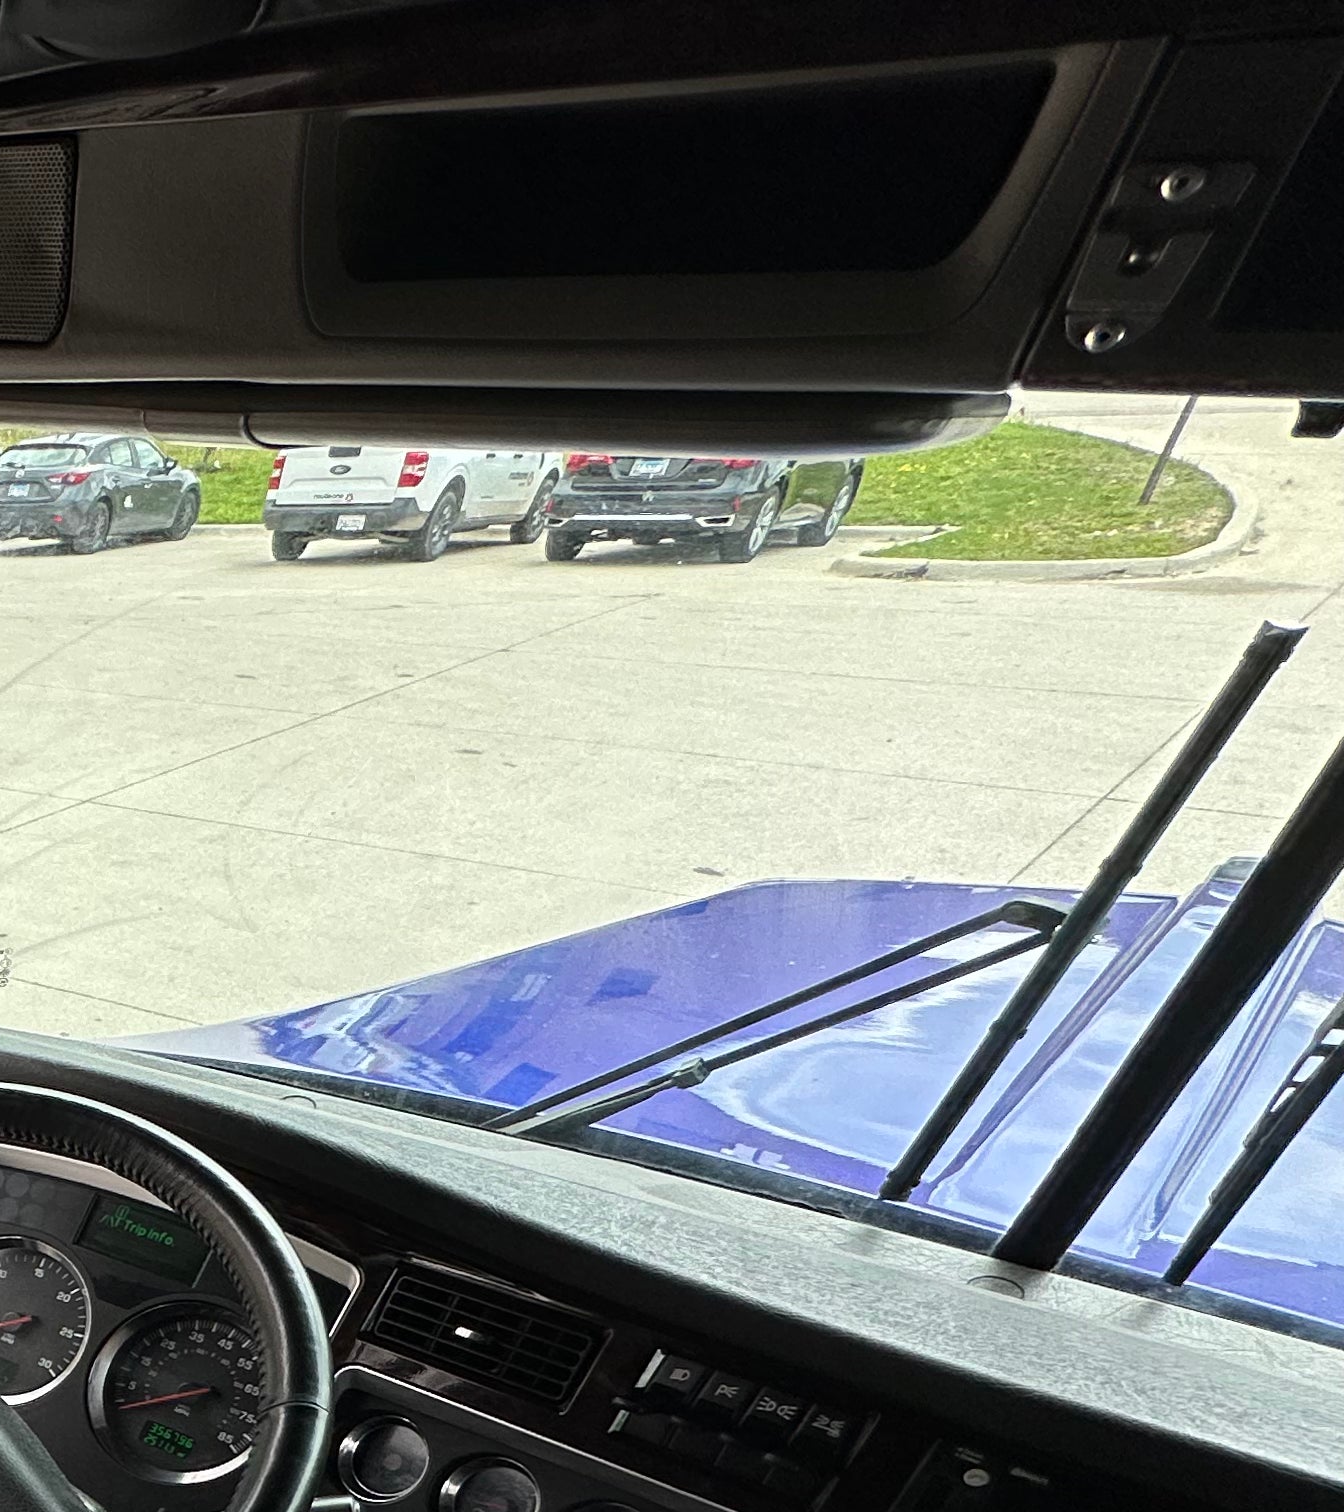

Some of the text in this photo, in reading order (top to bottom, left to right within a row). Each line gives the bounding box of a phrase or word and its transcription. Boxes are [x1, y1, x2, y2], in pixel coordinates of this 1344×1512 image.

[124, 1219, 147, 1237] Trip
[34, 1268, 45, 1278] 15
[56, 1291, 71, 1303] 20
[59, 1327, 74, 1339] 25
[188, 1331, 205, 1344] 35
[160, 1338, 177, 1350] 25
[217, 1338, 234, 1351] 45
[37, 1357, 52, 1369] 30
[237, 1357, 254, 1371] 55
[128, 1381, 138, 1391] 5
[243, 1384, 260, 1397] 65
[238, 1411, 254, 1424] 75
[217, 1431, 234, 1445] 85
